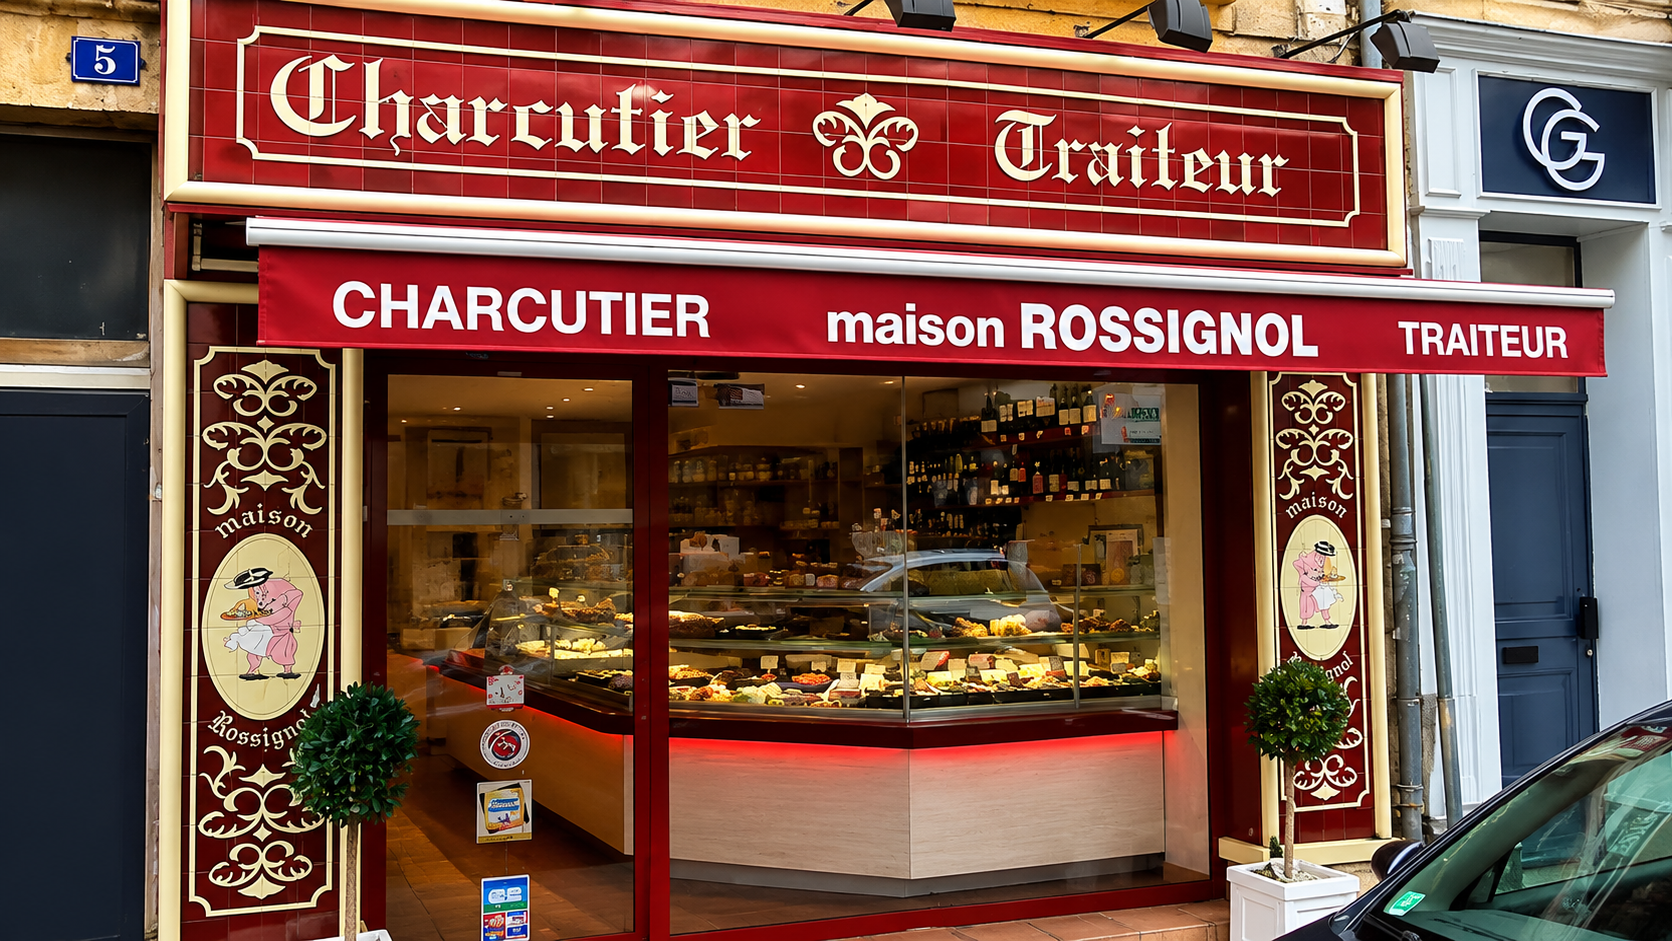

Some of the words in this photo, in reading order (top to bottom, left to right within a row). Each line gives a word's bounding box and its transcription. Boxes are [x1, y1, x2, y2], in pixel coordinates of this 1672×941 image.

[94, 44, 116, 75] 5
[270, 54, 762, 162] Charcutier
[994, 109, 1290, 198] Traiteur
[332, 280, 711, 339] CHARCUTIER
[827, 302, 1005, 348] maison
[1020, 302, 1320, 358] ROSSIGNOL
[1397, 321, 1569, 360] TRAITEUR
[214, 502, 314, 539] maison
[1285, 491, 1348, 519] maison
